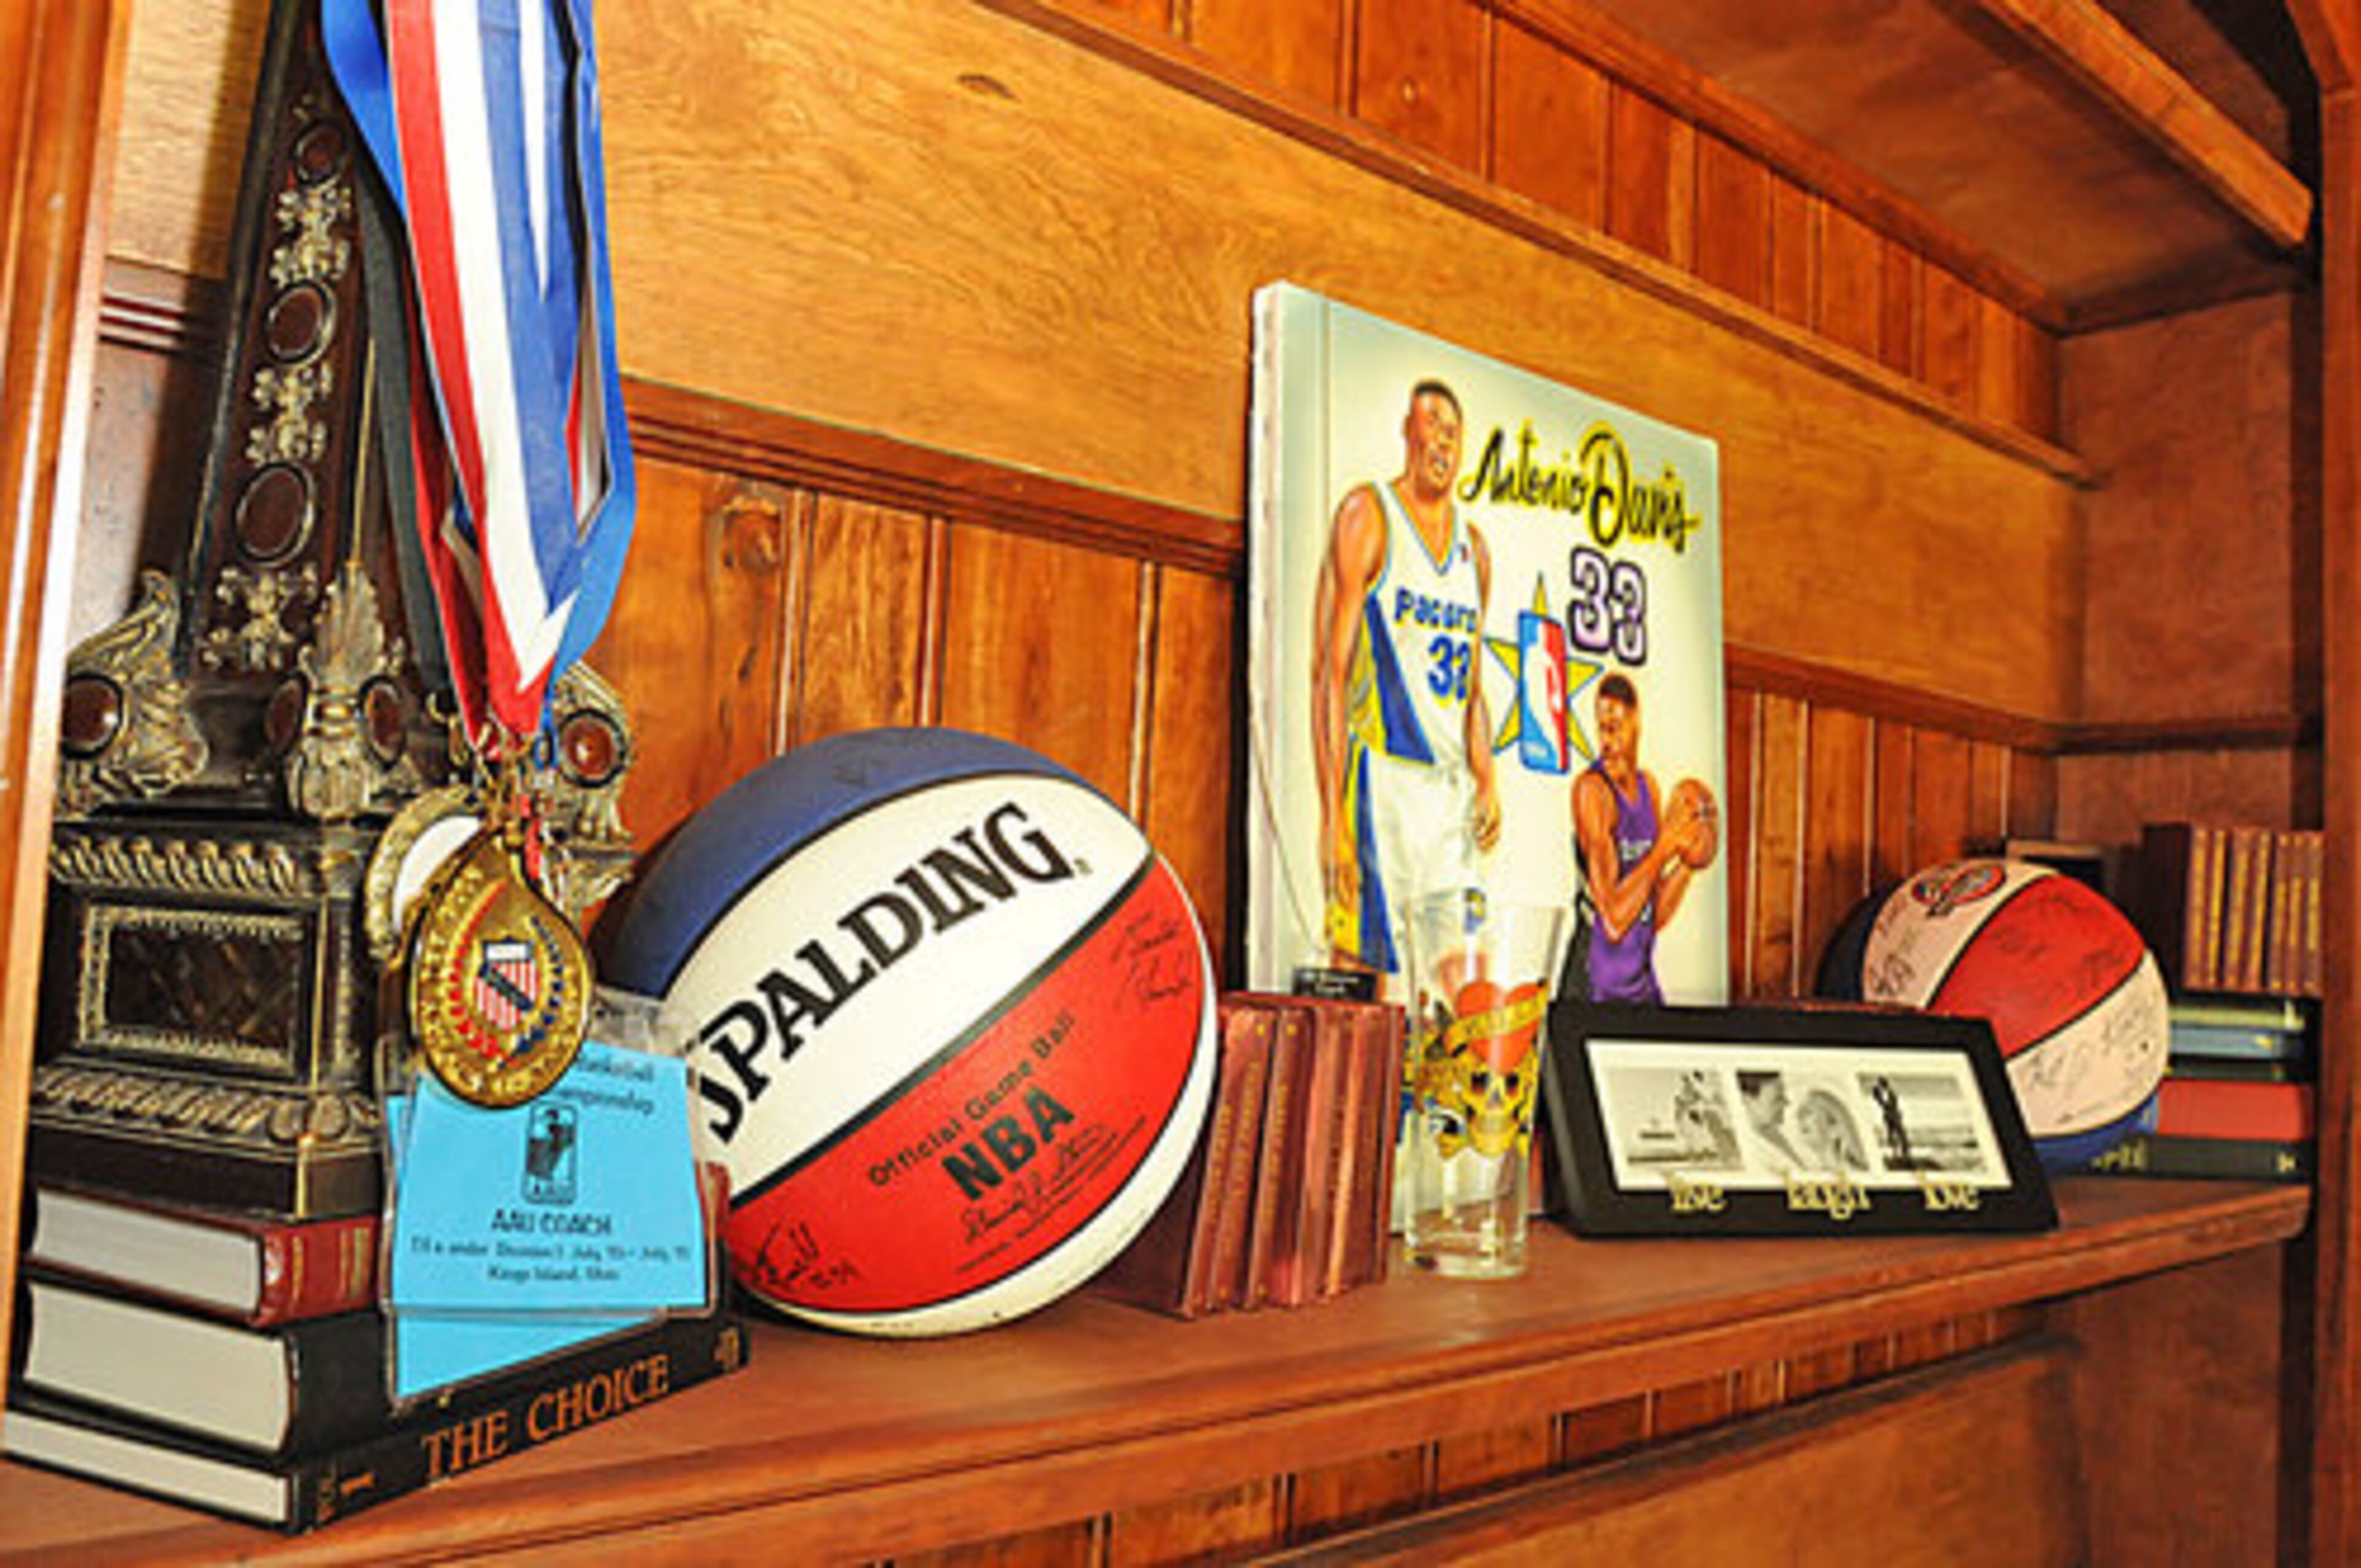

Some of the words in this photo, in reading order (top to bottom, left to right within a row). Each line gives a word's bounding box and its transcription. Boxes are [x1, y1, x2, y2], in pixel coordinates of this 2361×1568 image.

[1457, 419, 1589, 515] Antonio
[1579, 421, 1702, 552] Davis
[1567, 545, 1647, 667] 33
[869, 1117, 964, 1186] Official
[965, 1060, 1032, 1120] Game
[1031, 1012, 1074, 1059] Ball
[942, 1087, 1075, 1200] NBA
[449, 1240, 488, 1256] under
[496, 1241, 552, 1259] Division
[492, 1209, 534, 1233] AAU
[539, 1213, 612, 1236] COACH
[421, 1410, 509, 1477] THE
[527, 1355, 669, 1443] CHOICE
